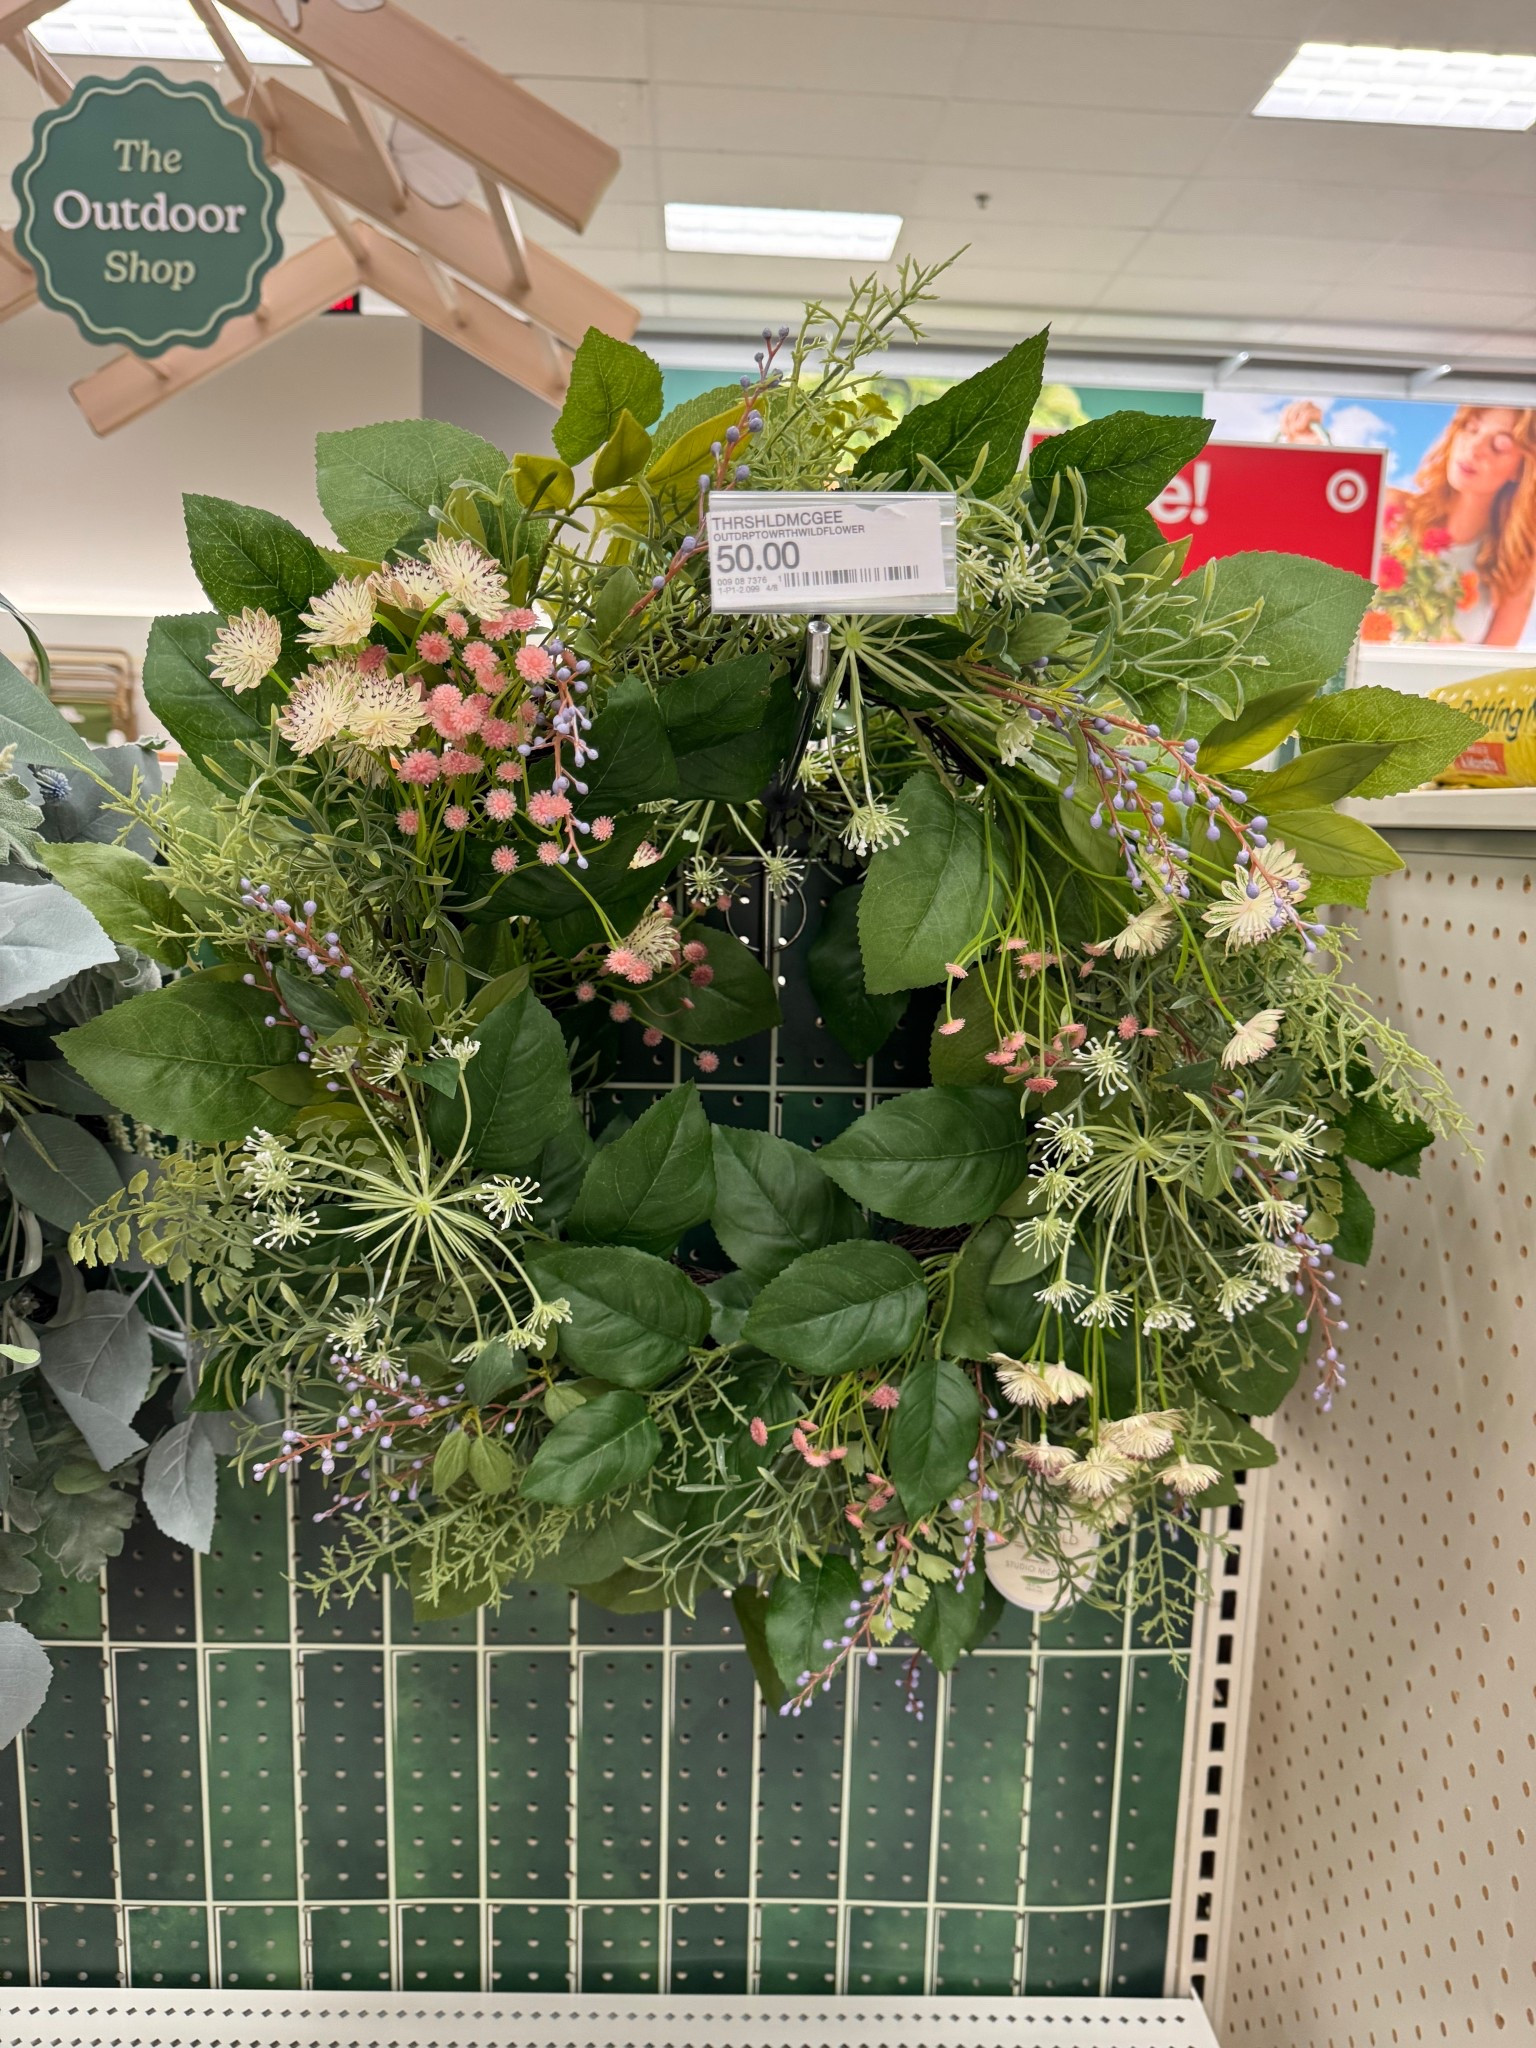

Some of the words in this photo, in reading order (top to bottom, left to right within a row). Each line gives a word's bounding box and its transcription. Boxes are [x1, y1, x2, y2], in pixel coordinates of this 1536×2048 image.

[113, 138, 183, 174] The
[53, 189, 247, 234] Outdoor
[104, 250, 196, 292] Shop
[712, 509, 844, 531] THRSHLDMCGEE
[713, 524, 866, 542] OUTDRPTOWRTHWILDFLOWER
[716, 541, 801, 574] 50.00
[717, 578, 733, 586] 009
[735, 577, 745, 586] 08
[747, 576, 768, 585] 7376
[1005, 1559, 1036, 1573] STUDIO
